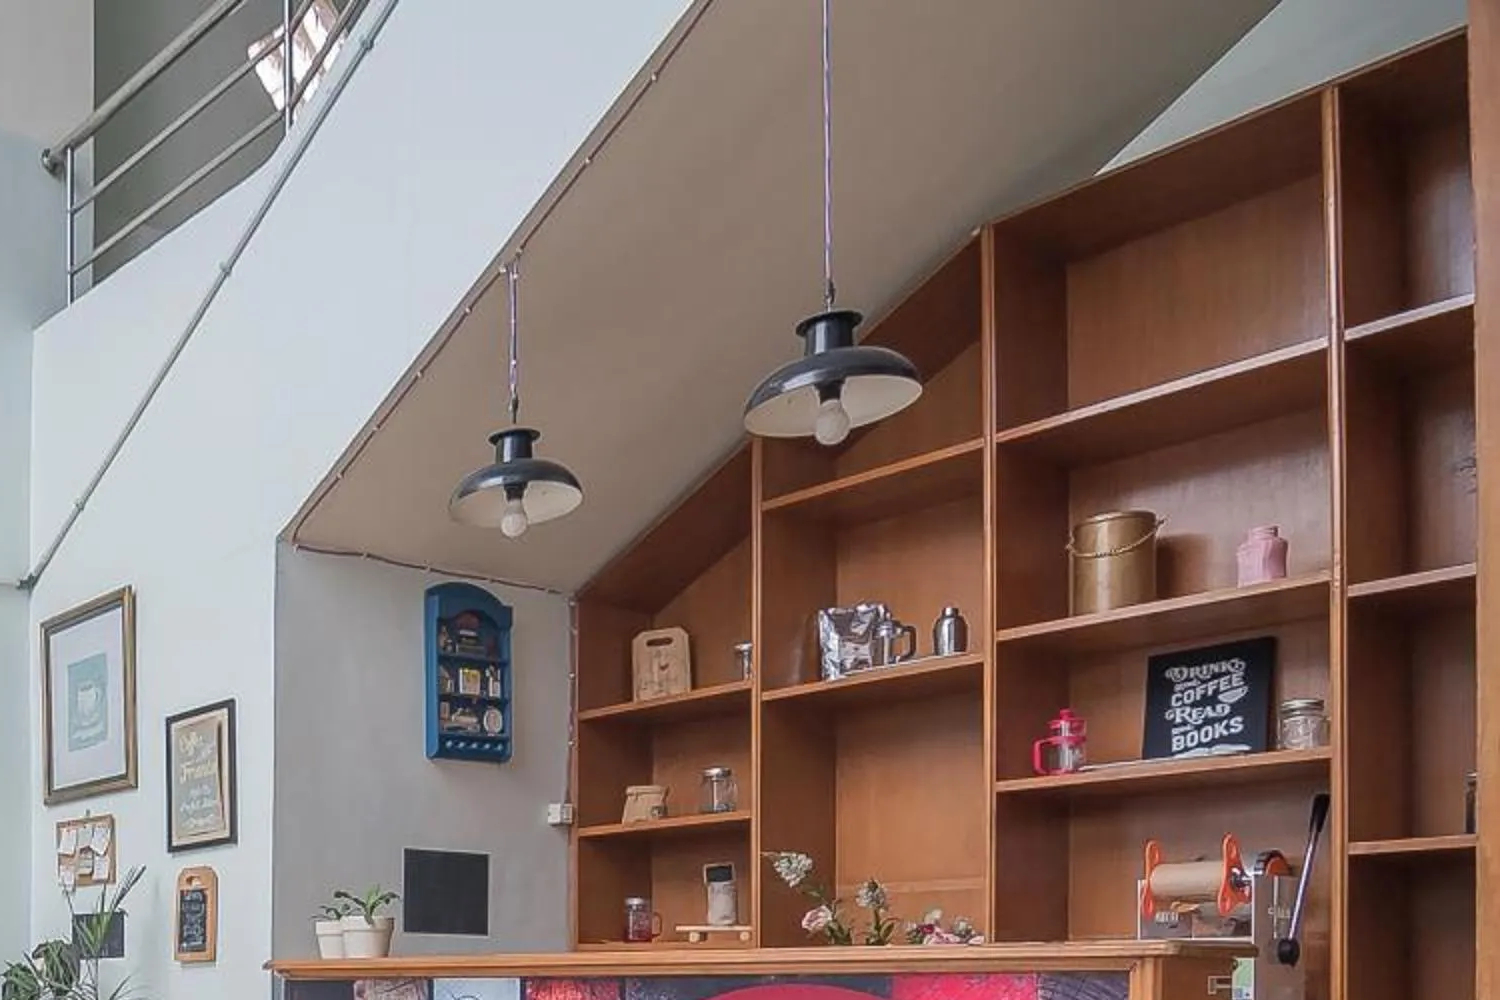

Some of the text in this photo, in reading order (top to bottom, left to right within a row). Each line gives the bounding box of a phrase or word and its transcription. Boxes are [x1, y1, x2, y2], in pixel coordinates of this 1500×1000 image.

[1164, 658, 1246, 683] DRINK
[1171, 671, 1245, 707] COFFEE
[1164, 703, 1231, 725] READ
[1171, 716, 1244, 752] BOOKS
